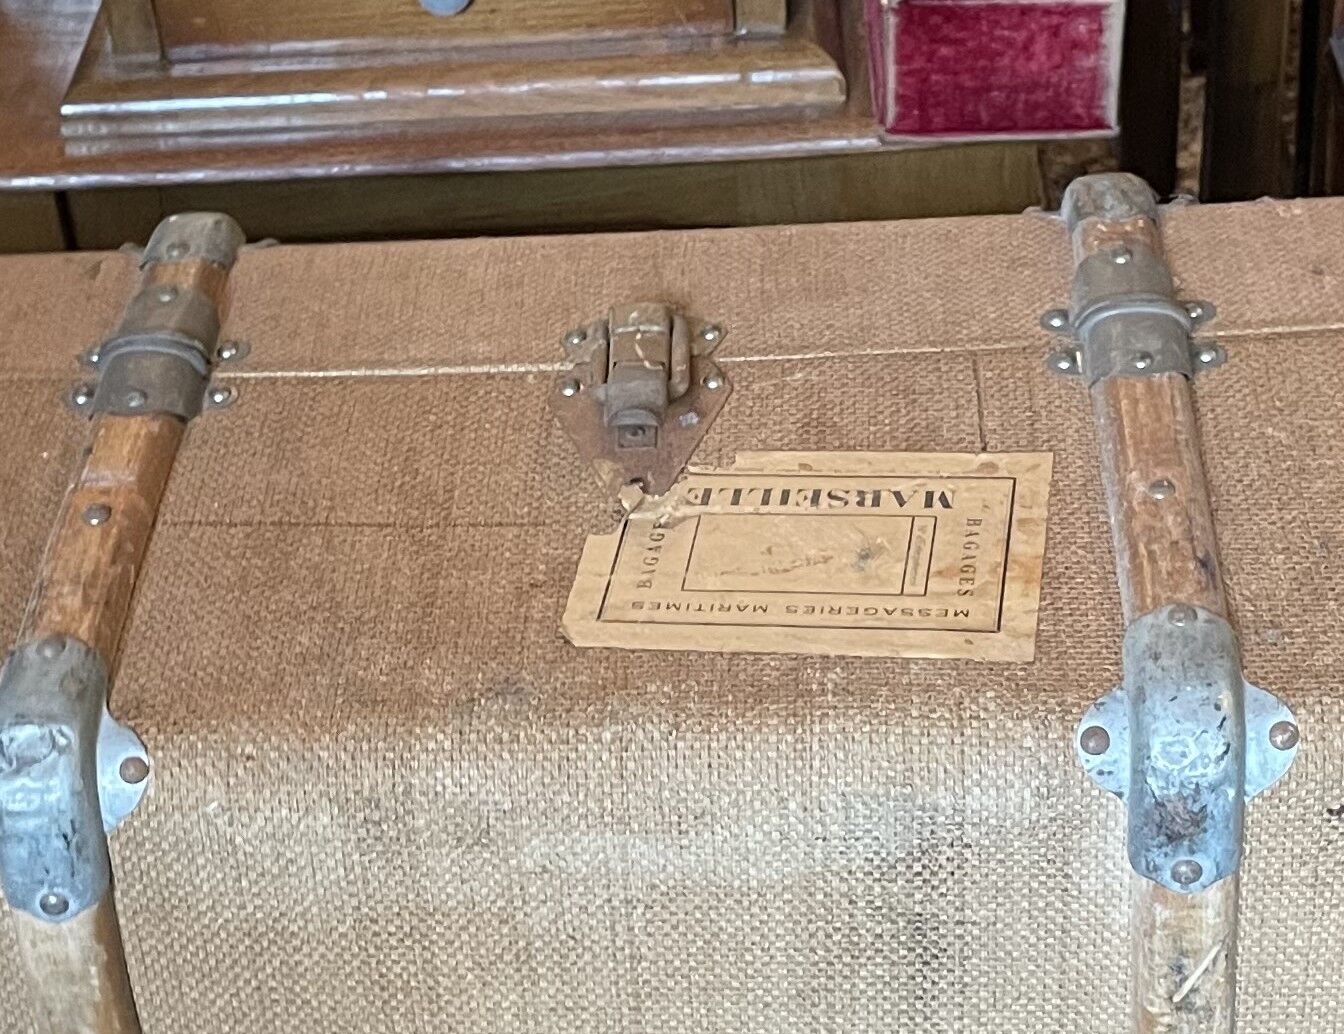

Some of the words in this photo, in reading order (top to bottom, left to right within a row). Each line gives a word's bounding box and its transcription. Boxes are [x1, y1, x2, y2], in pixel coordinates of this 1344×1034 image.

[687, 486, 955, 510] MARSEILLE
[957, 516, 983, 598] BAGAGES
[631, 600, 769, 614] MARITIMES
[785, 603, 971, 619] MESSAGERIES
